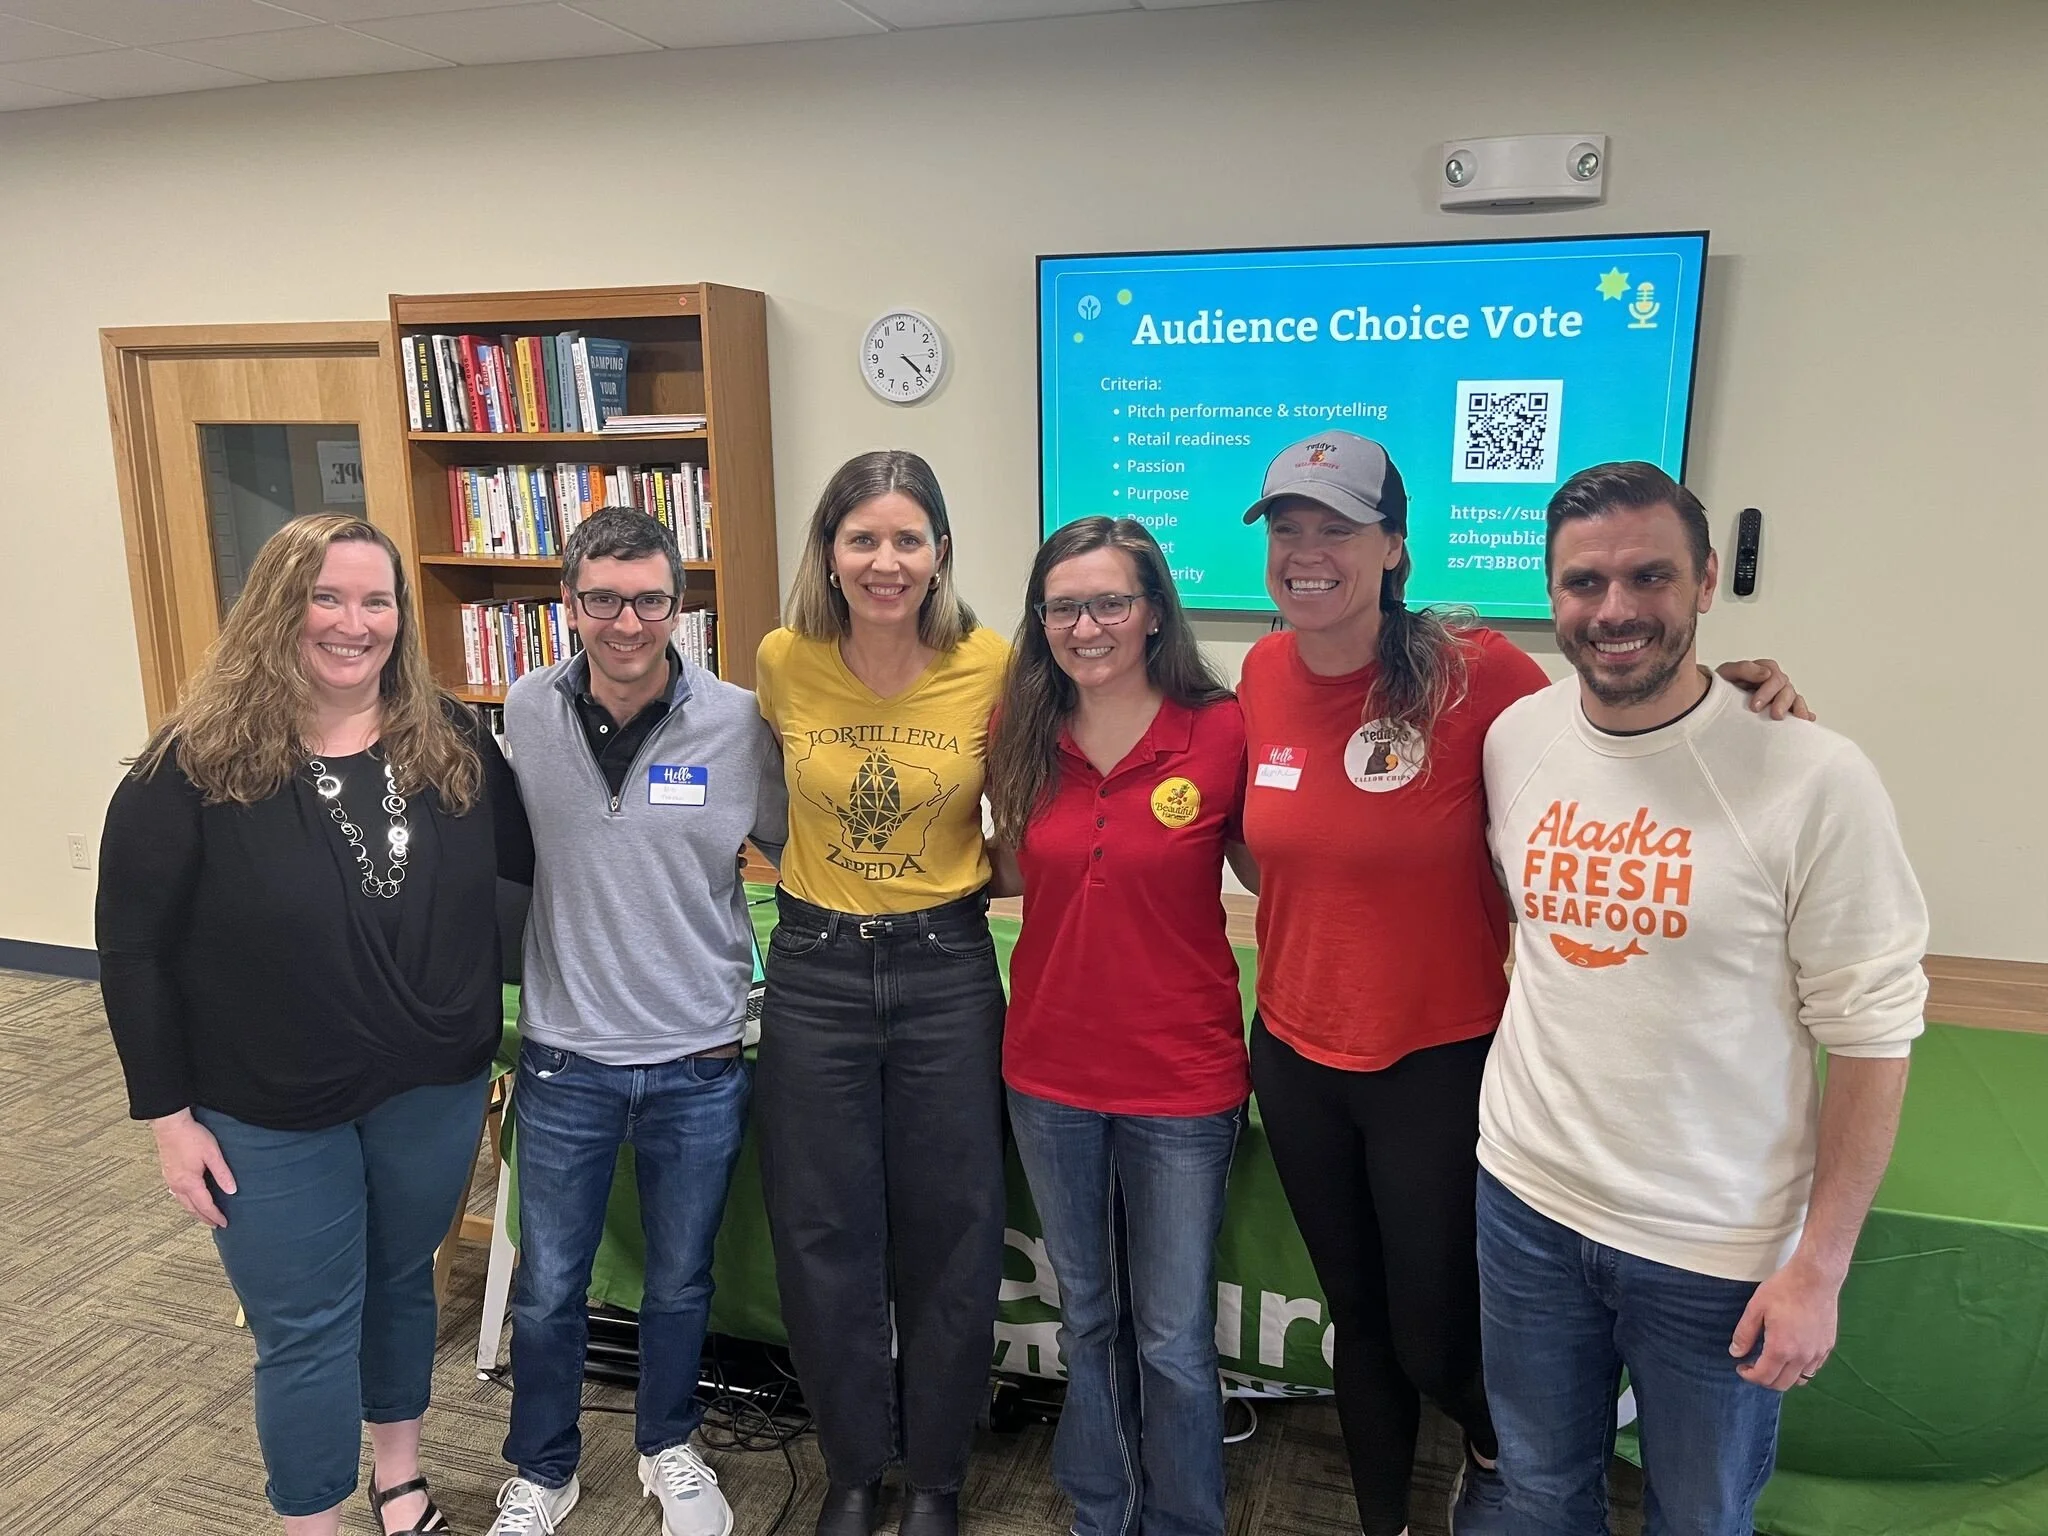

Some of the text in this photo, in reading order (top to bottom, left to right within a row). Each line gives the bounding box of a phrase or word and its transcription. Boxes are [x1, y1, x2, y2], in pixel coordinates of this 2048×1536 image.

[885, 327, 889, 336] 11
[896, 321, 905, 331] 12
[913, 324, 915, 332] 1
[1132, 304, 1583, 345] Audience Choice Vote
[875, 339, 883, 348] 10
[923, 334, 929, 343] 2
[418, 343, 426, 357] TOOLS
[928, 349, 934, 358] 3
[590, 356, 623, 371] RAMPING
[872, 354, 878, 363] 9
[878, 369, 884, 378] 8
[925, 365, 931, 373] 4
[600, 382, 617, 395] YOUR
[889, 379, 894, 388] 7
[903, 382, 909, 391] 6
[916, 377, 922, 386] 5
[1101, 377, 1162, 390] Criteria:
[470, 396, 478, 420] GREAT
[1128, 403, 1387, 422] Pitch performance & storytelling
[1128, 432, 1251, 446] Retail readiness
[1128, 459, 1185, 473] Passion
[1127, 487, 1189, 503] Purpose
[806, 725, 960, 754] TORTILLERIA
[1269, 747, 1294, 762] Hello
[664, 767, 693, 783] Hello
[1354, 775, 1383, 783] TALLOW
[1155, 802, 1194, 816] Beautiful
[1528, 800, 1692, 858] Alaska
[825, 843, 926, 881] ZEPEDA
[1523, 850, 1692, 906] FRESH
[1524, 893, 1688, 938] SEAFOOD
